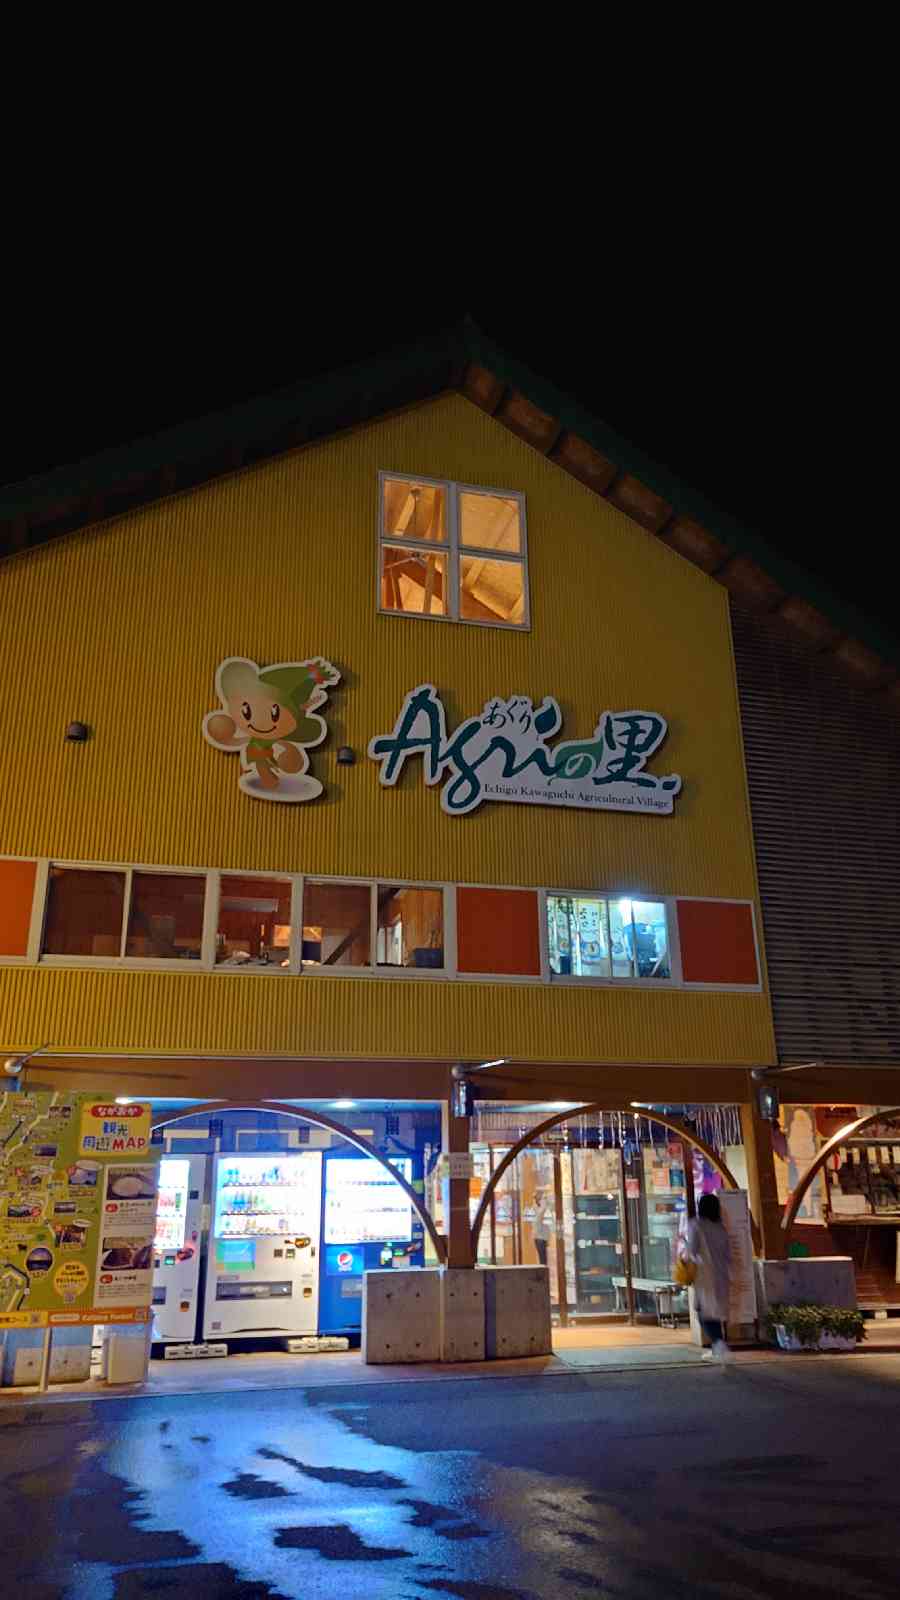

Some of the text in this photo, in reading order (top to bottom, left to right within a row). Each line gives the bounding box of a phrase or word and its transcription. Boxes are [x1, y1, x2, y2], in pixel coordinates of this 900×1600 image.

[483, 700, 532, 733] あぐり
[484, 783, 669, 808] Echigo Kawaguchi Agricultural Village
